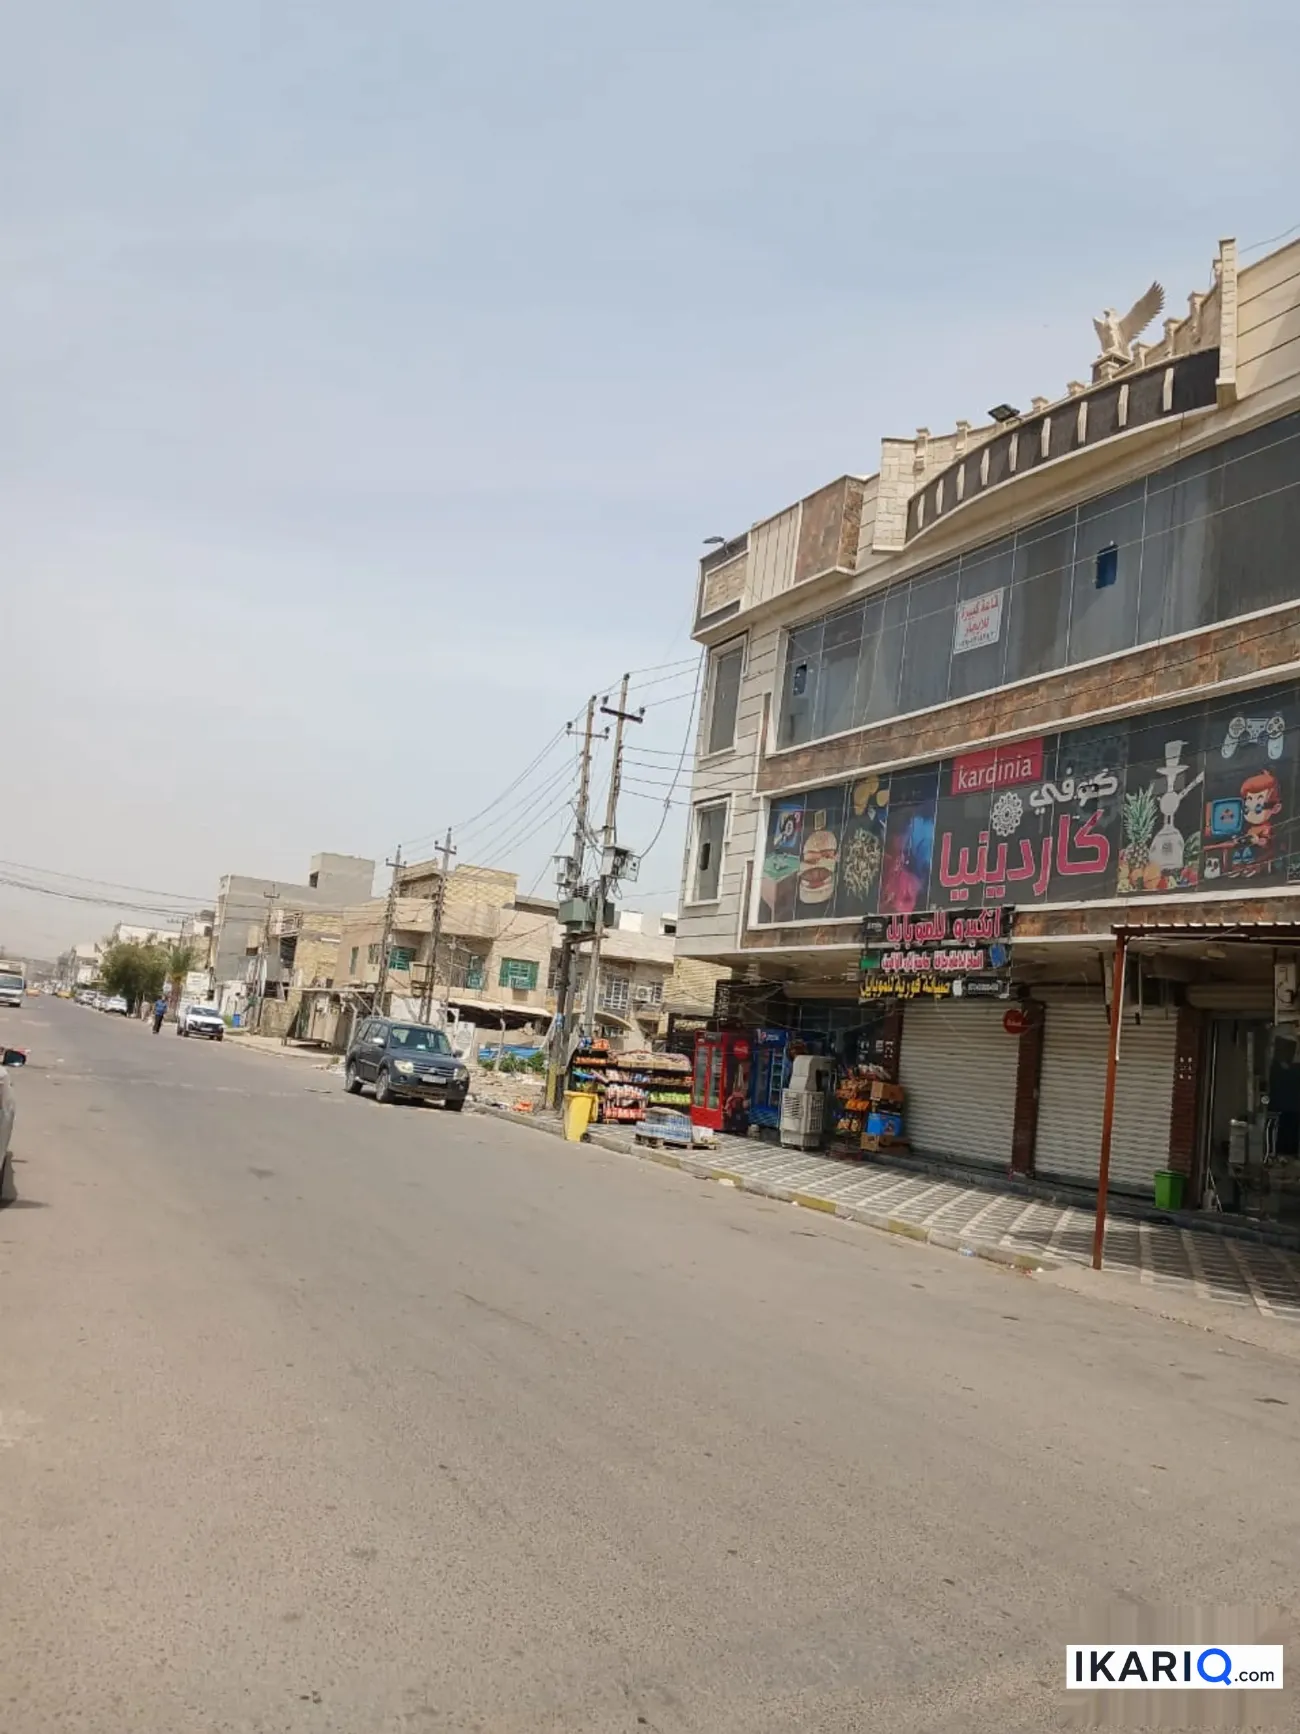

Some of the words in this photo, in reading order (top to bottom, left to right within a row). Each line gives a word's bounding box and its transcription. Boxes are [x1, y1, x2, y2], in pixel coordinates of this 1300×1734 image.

[958, 756, 1033, 790] kardinia
[1029, 767, 1118, 815] كوفي
[939, 809, 1110, 901] كاردينيا
